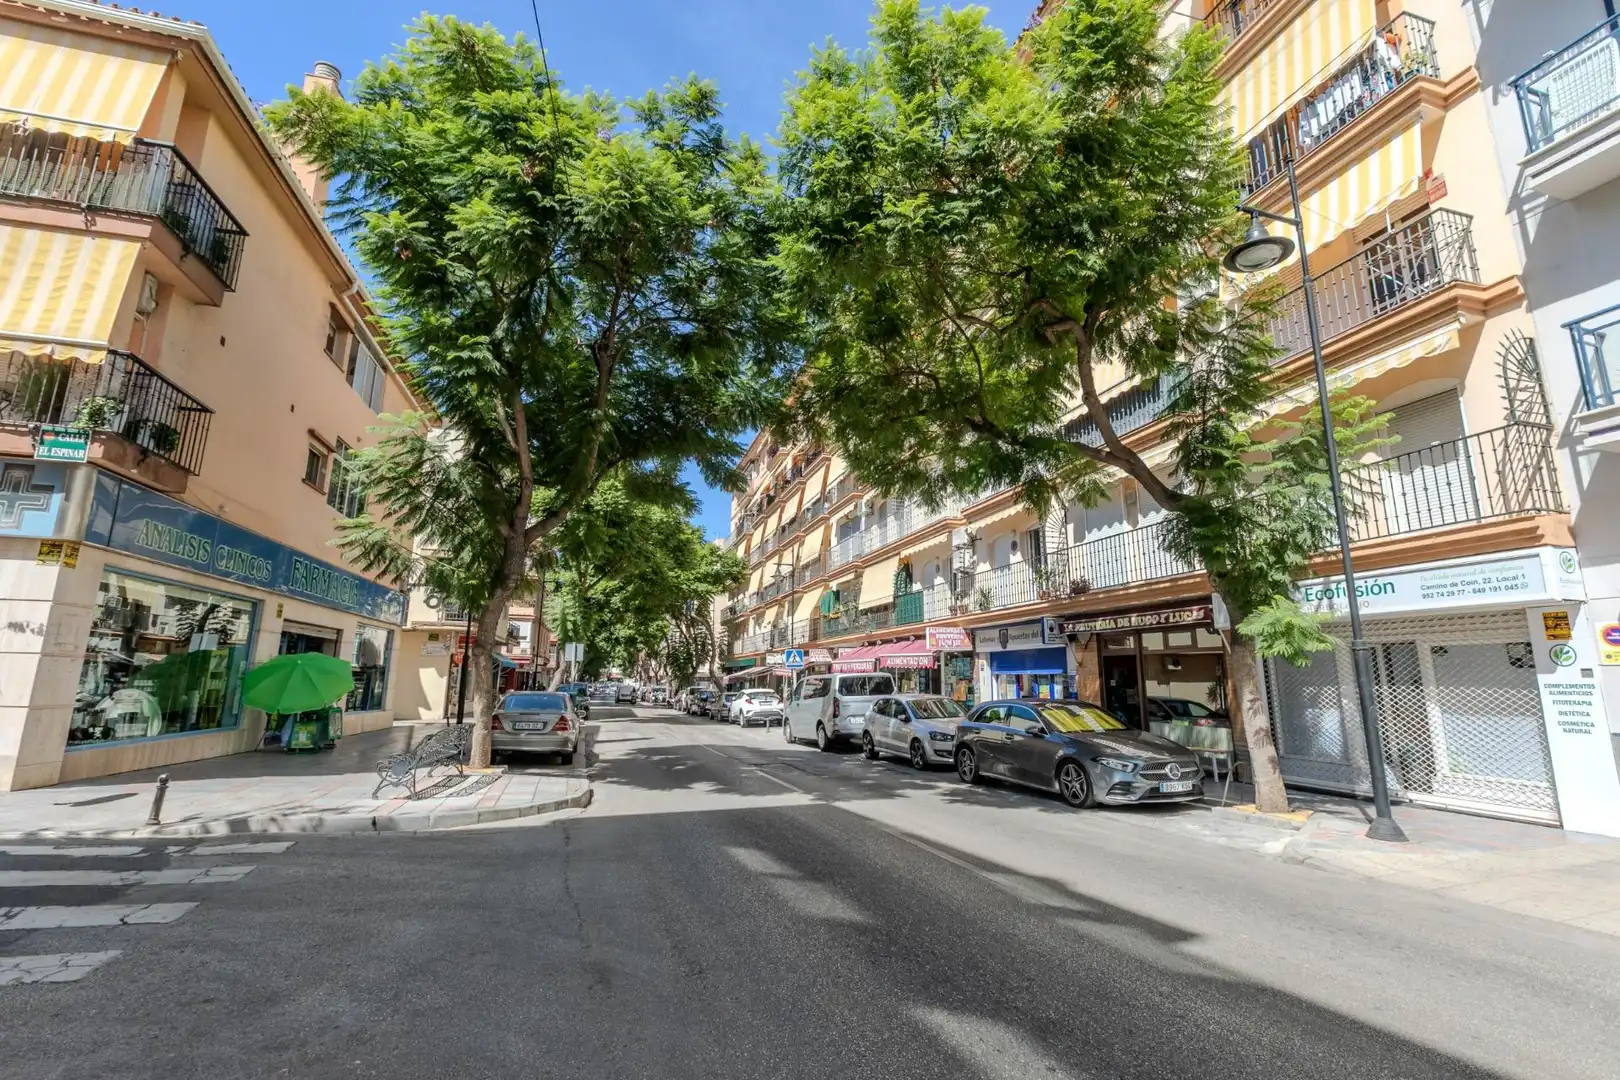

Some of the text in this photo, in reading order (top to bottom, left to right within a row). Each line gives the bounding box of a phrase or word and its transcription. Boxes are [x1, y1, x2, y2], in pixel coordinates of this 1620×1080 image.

[58, 433, 87, 443] CALLE
[38, 446, 85, 458] EL ESPINAR
[135, 518, 272, 581] ANALISIS CLINICOS
[289, 556, 360, 607] FARMACIA
[1420, 583, 1448, 591] Camino
[1496, 574, 1519, 583] Local
[1489, 585, 1501, 593] 191
[1504, 583, 1520, 591] 045
[1117, 617, 1130, 628] DE
[1131, 614, 1160, 626] HUGO
[1160, 613, 1169, 623] Y
[1169, 609, 1205, 623] LUCAS
[1031, 629, 1039, 638] del
